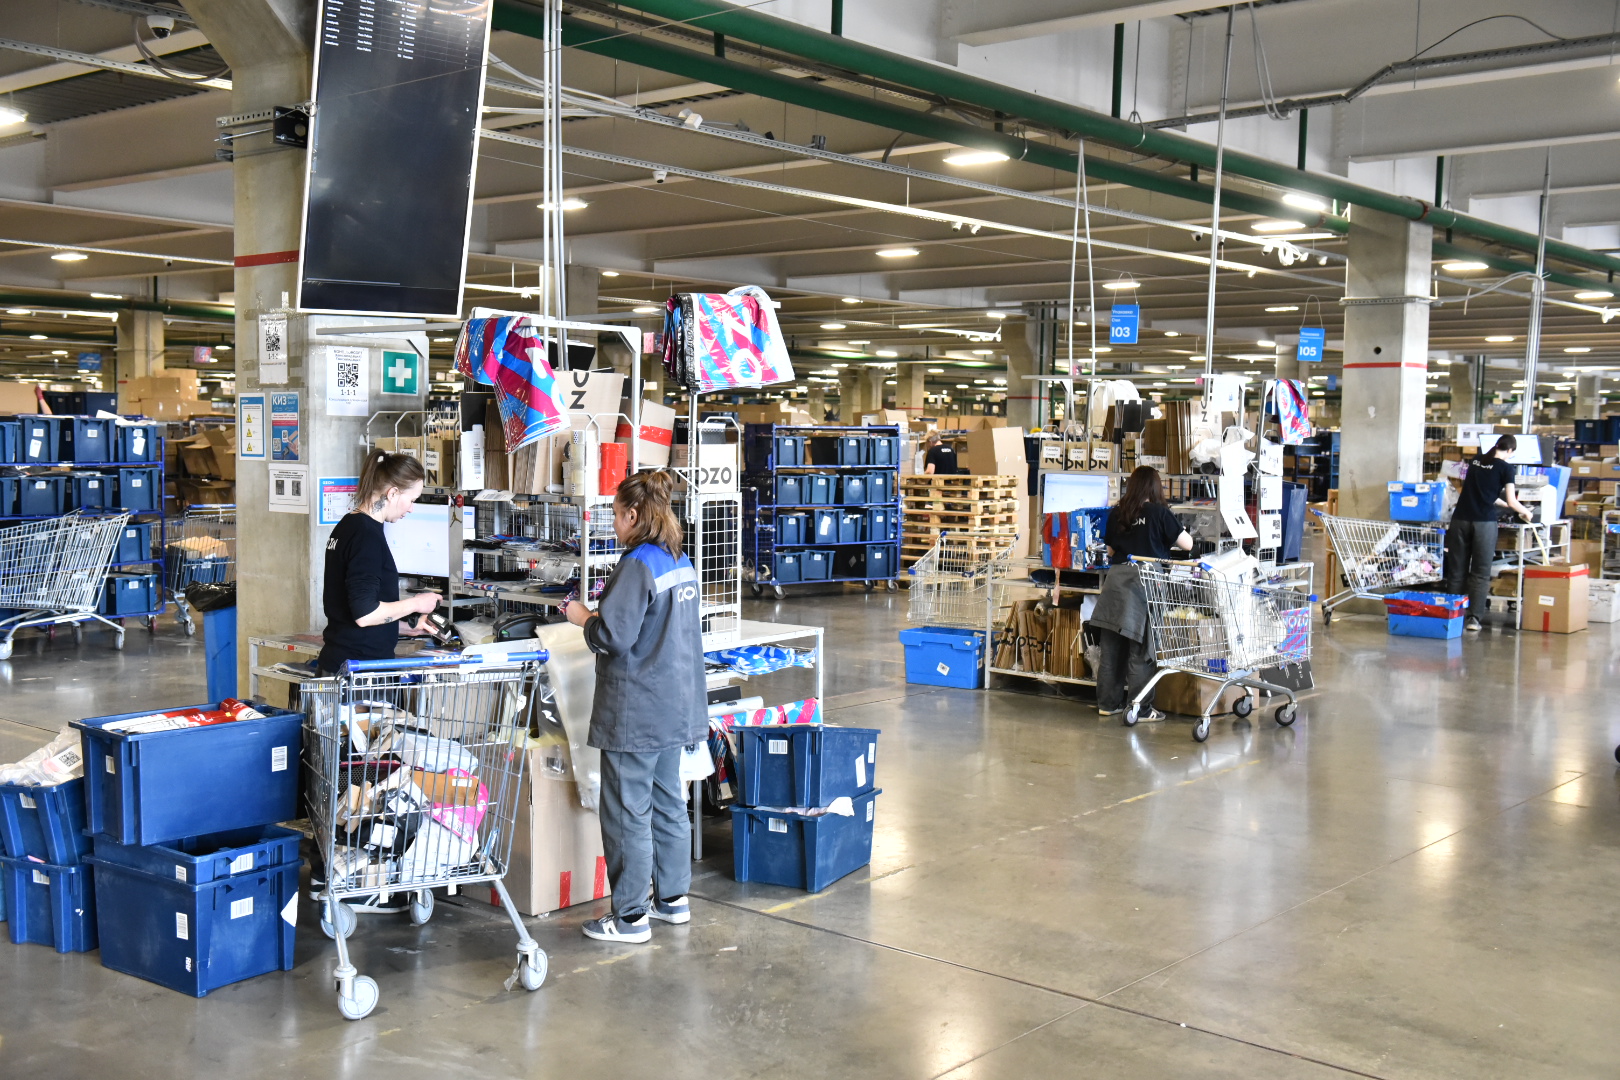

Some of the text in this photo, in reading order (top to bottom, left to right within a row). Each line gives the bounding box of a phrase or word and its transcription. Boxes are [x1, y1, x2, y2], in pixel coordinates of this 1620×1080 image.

[1111, 326, 1131, 338] 103
[1299, 346, 1317, 357] 105
[272, 395, 287, 406] КИЗ
